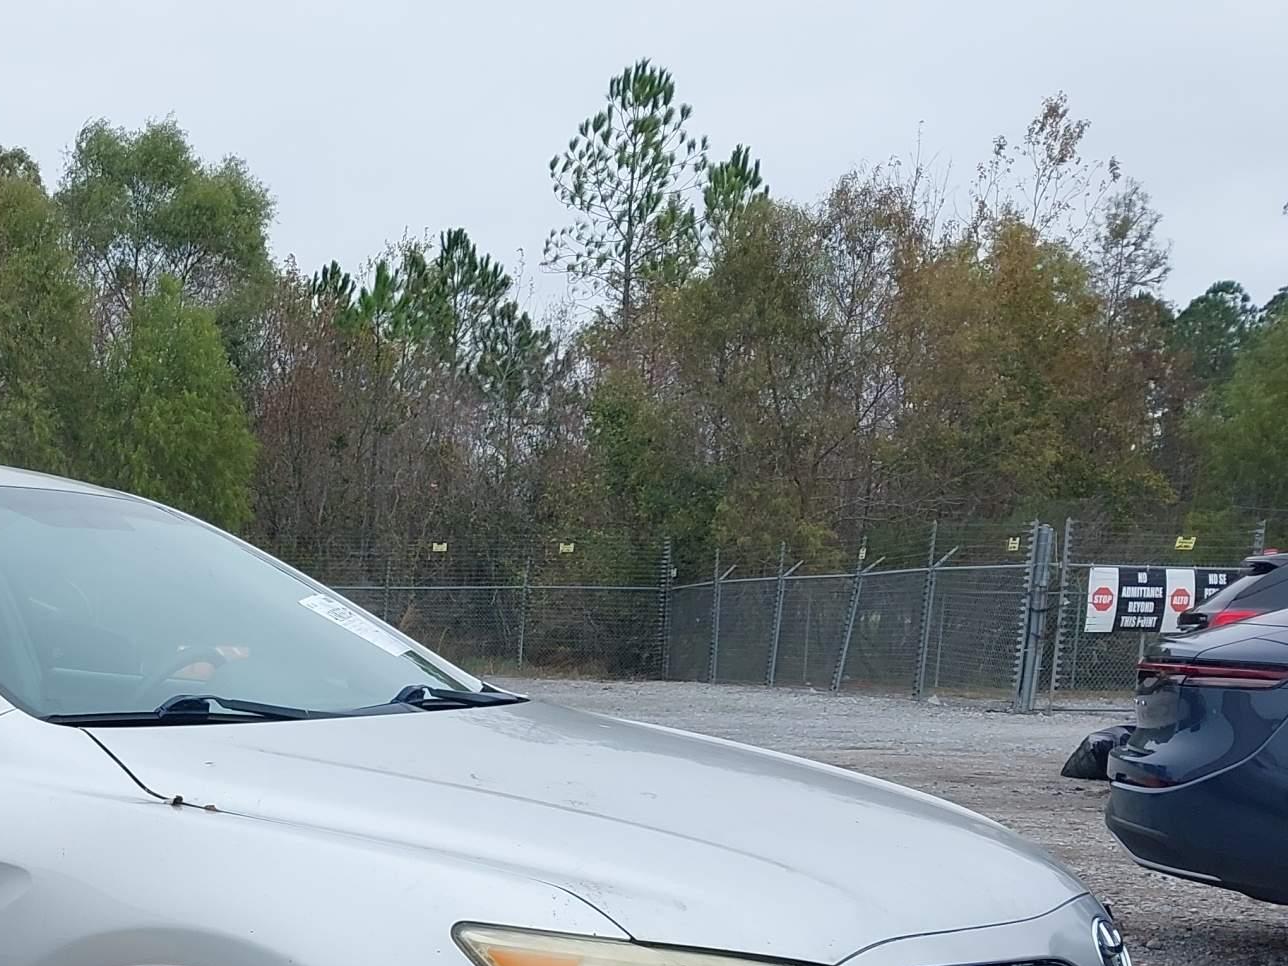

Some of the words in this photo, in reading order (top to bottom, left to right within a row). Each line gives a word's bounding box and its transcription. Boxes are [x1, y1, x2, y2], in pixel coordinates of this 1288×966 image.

[1138, 572, 1148, 583] NO
[1208, 573, 1218, 585] NO
[1219, 573, 1227, 585] SE
[1121, 586, 1163, 598] ADMITTANCE
[1093, 595, 1113, 604] STOP
[1172, 595, 1189, 605] ALTO
[1128, 601, 1155, 613] BEYOND
[1120, 615, 1136, 627] THIS
[1136, 616, 1158, 627] POINT
